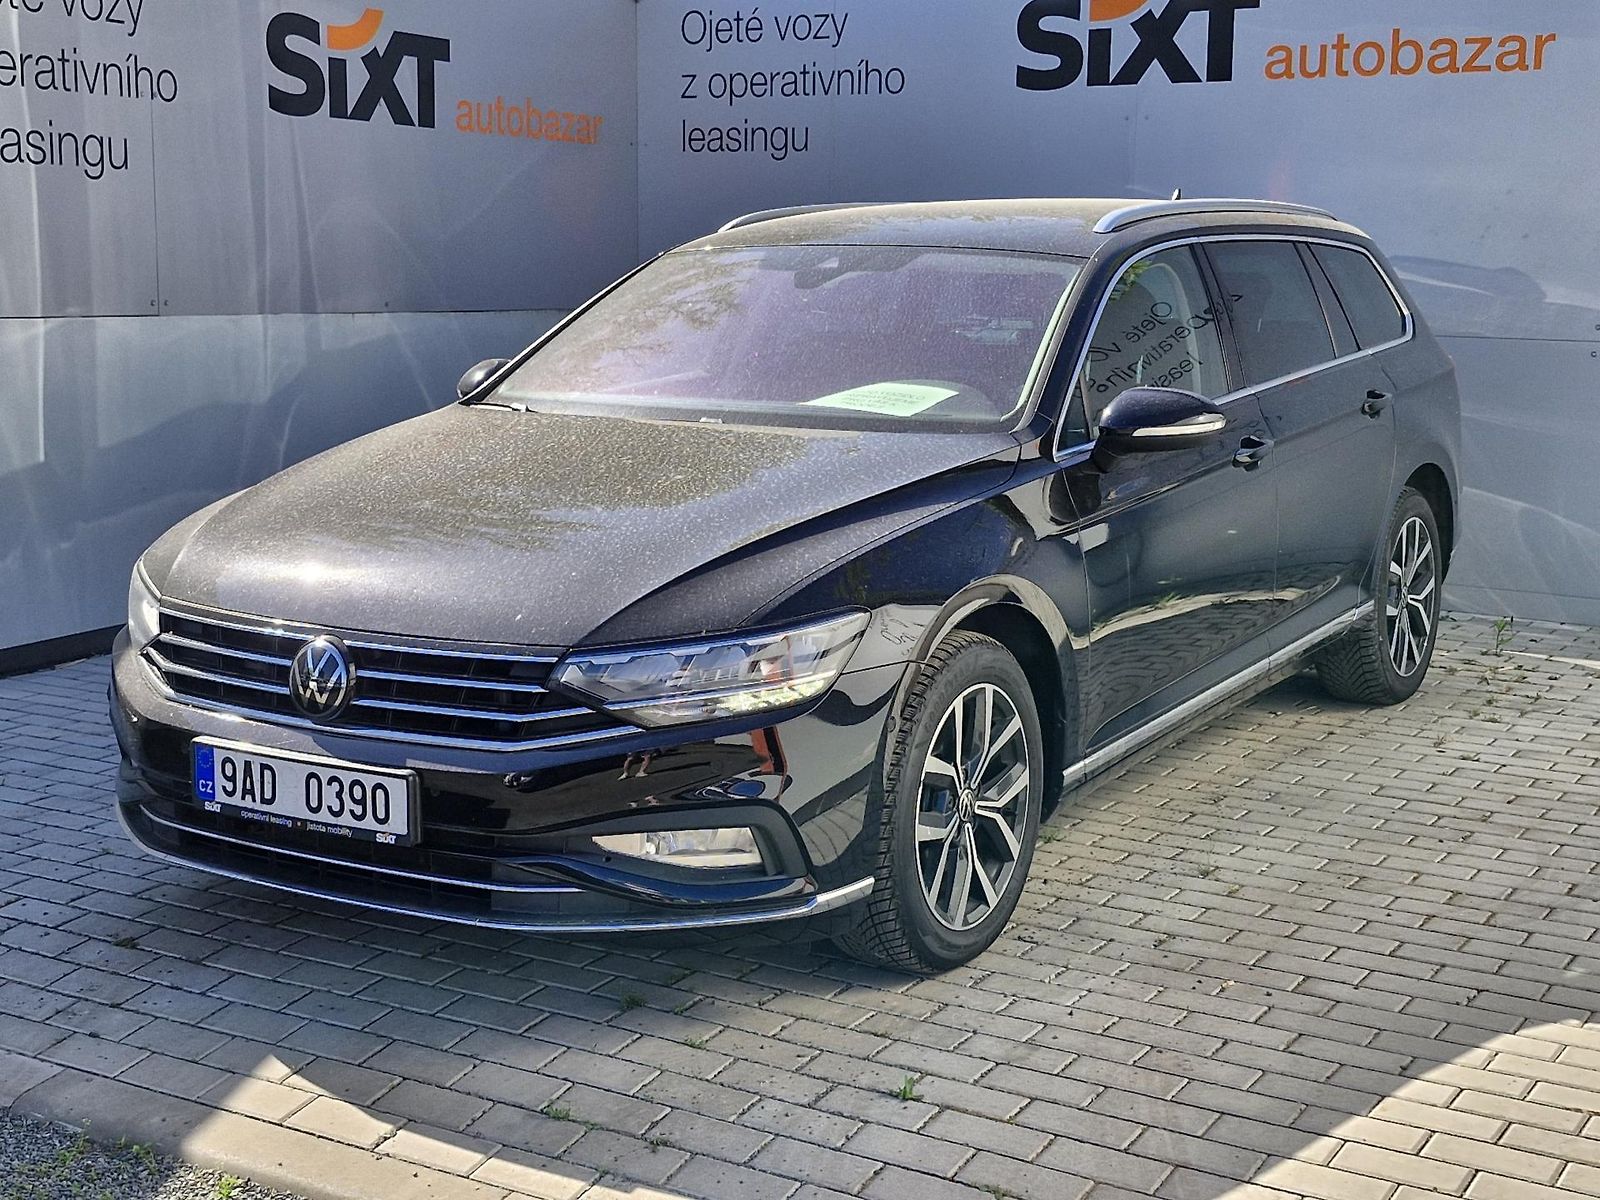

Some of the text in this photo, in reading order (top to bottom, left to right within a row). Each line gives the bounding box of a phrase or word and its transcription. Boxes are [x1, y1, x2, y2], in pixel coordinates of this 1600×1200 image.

[682, 7, 849, 52] Ojeté vozy
[1264, 28, 1556, 79] autobazar
[681, 59, 905, 106] z operativního
[455, 95, 604, 144] autobazar
[682, 118, 809, 161] leasingu
[0, 119, 129, 180] asingu
[198, 779, 213, 794] CZ
[220, 756, 391, 825] 9AD 0390
